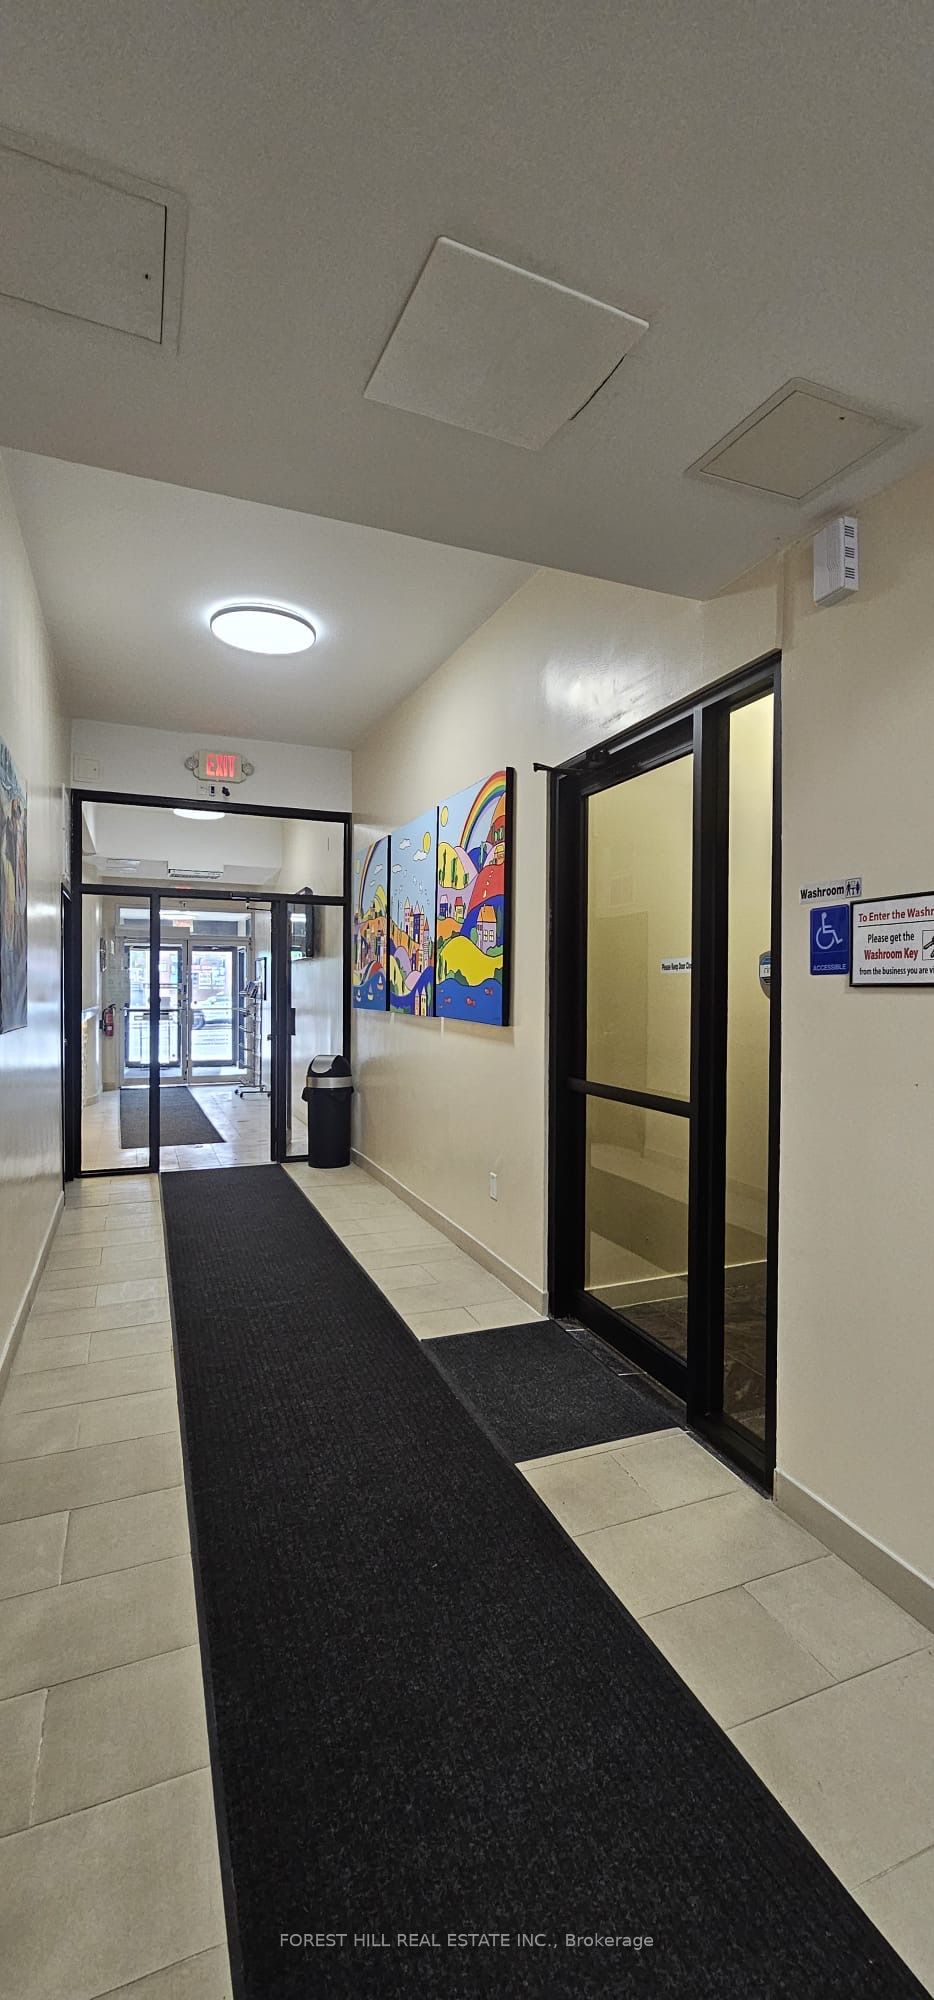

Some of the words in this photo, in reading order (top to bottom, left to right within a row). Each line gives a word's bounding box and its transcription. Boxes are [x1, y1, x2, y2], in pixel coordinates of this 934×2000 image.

[206, 753, 236, 777] EXIT
[801, 885, 844, 899] Washroom
[858, 913, 867, 922] To
[869, 911, 890, 921] Enter
[892, 908, 906, 919] the
[867, 934, 889, 944] Please
[890, 933, 901, 945] get
[902, 931, 914, 941] the
[864, 949, 902, 960] Washroom
[904, 947, 918, 961] Key
[813, 963, 847, 971] ACCESSIBLE
[859, 967, 872, 975] from
[873, 966, 881, 975] the
[882, 966, 906, 975] business
[907, 967, 918, 976] you
